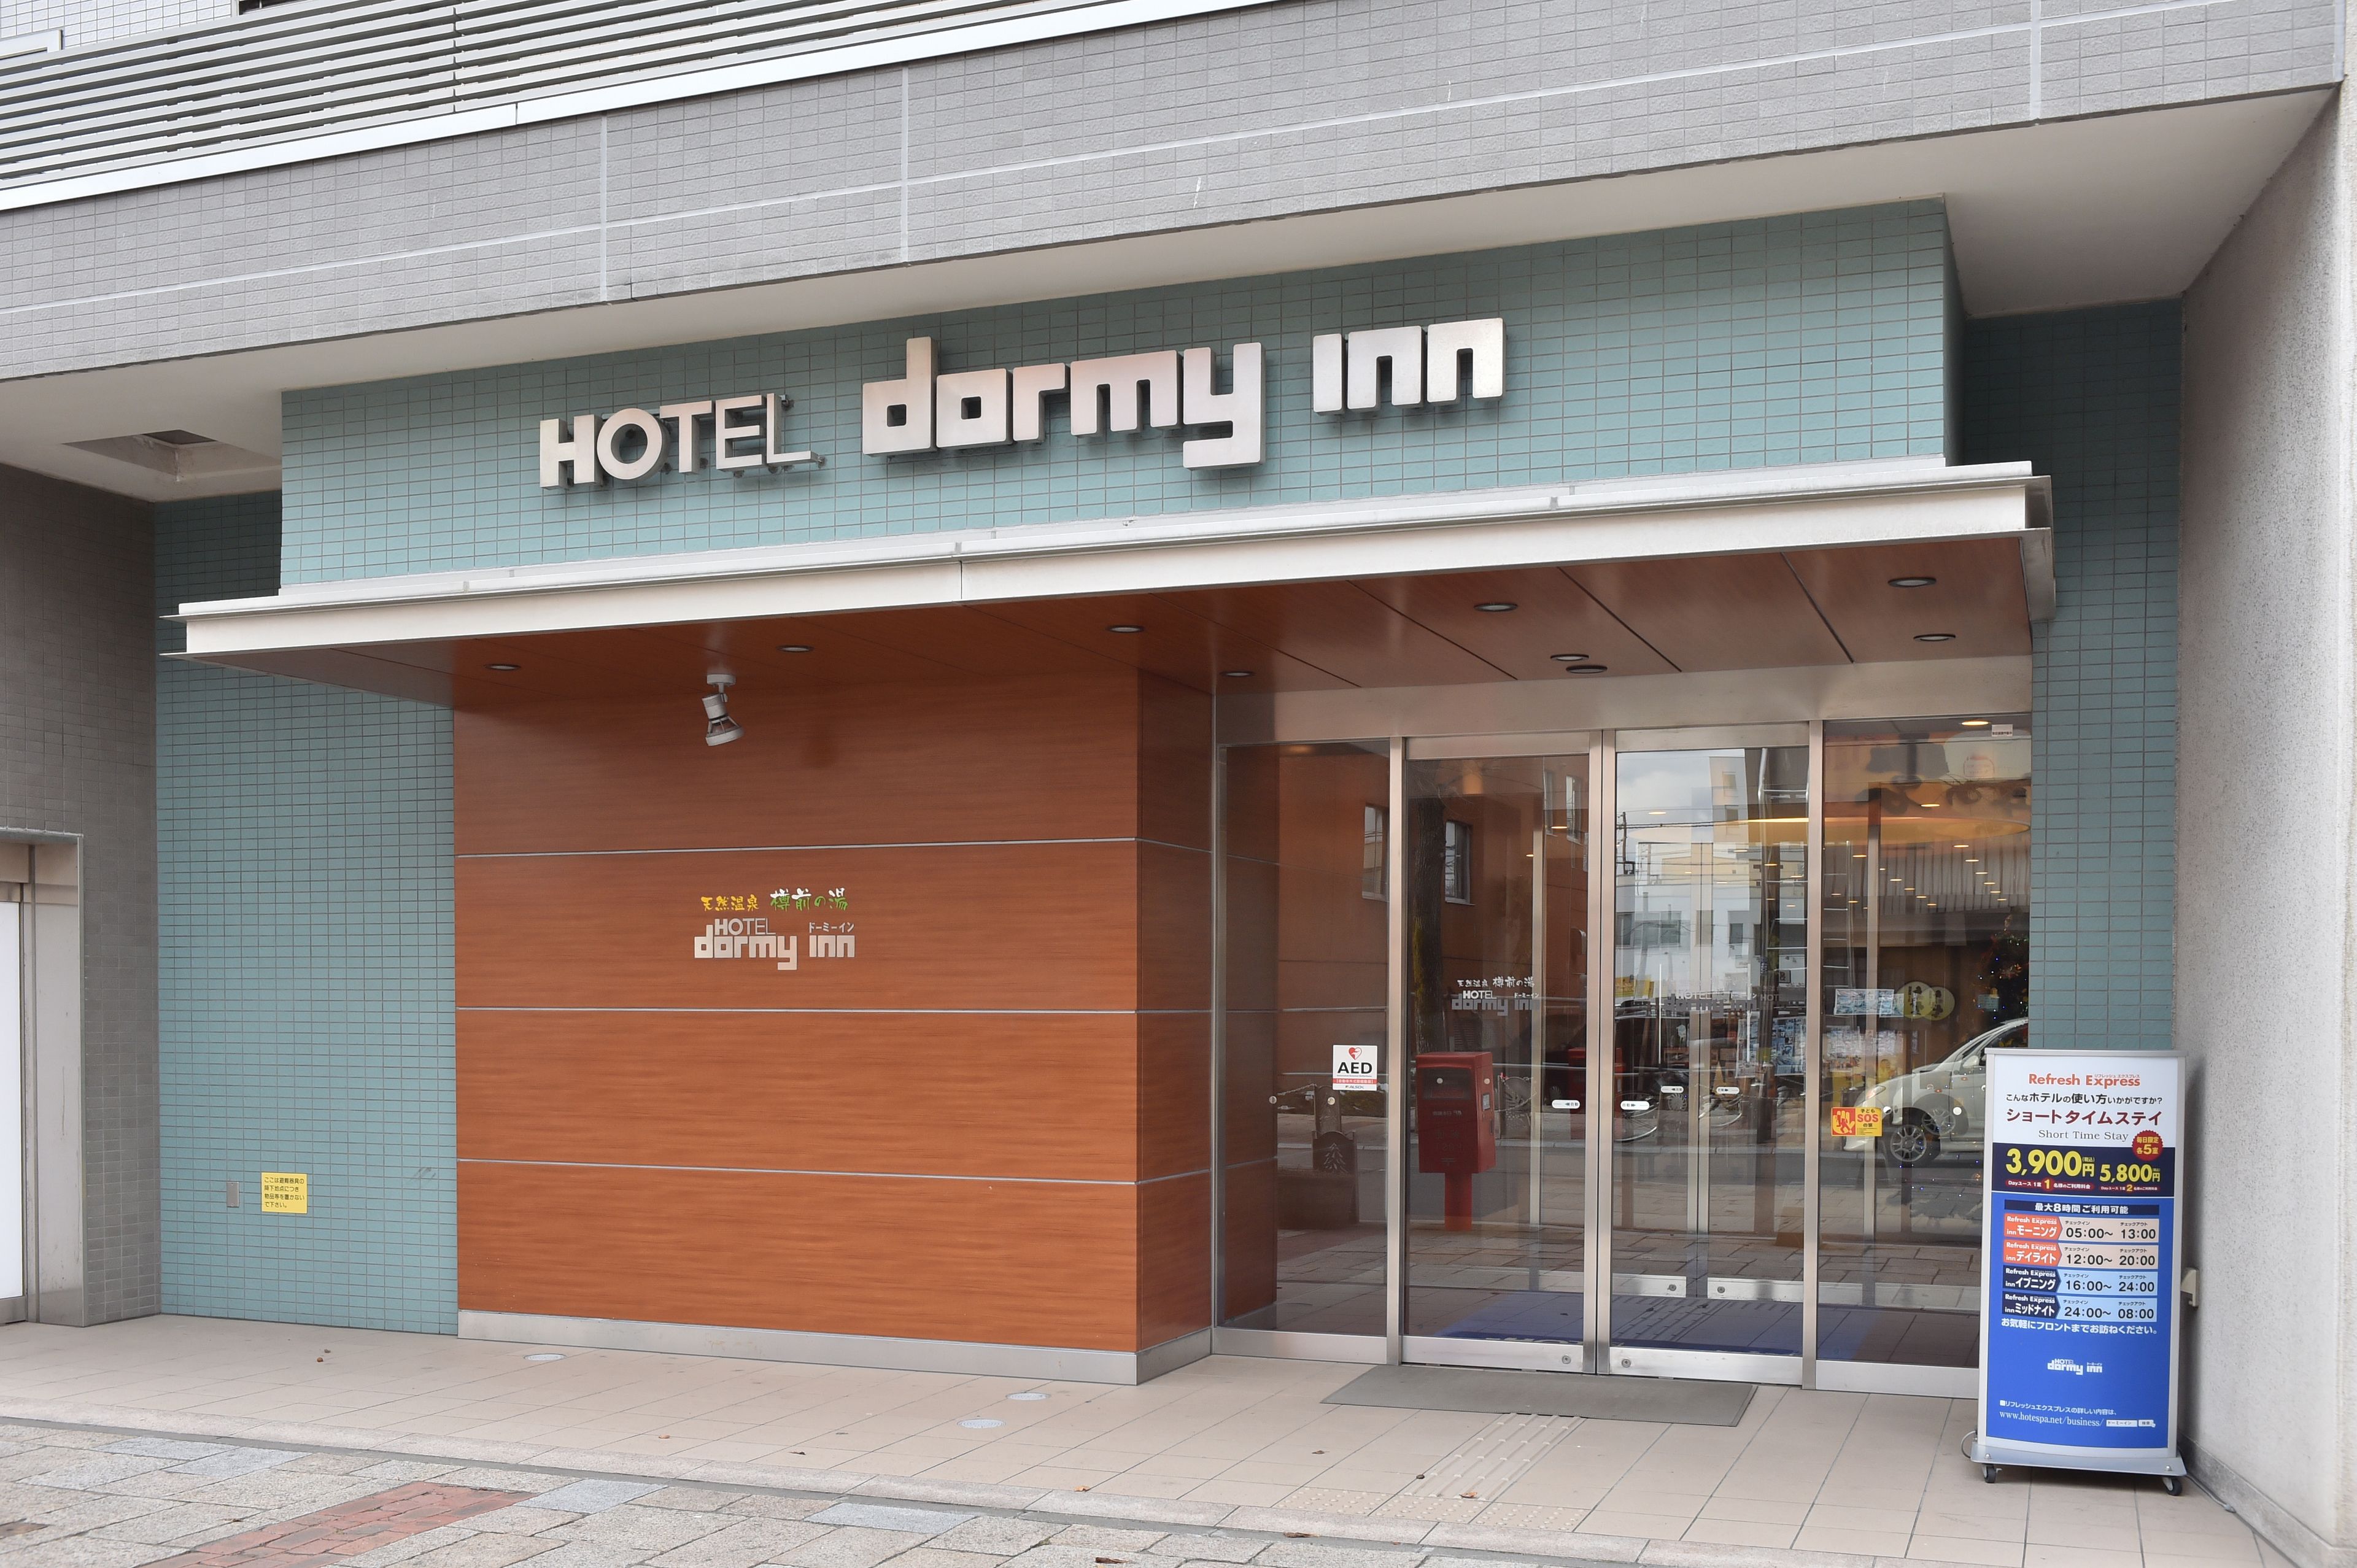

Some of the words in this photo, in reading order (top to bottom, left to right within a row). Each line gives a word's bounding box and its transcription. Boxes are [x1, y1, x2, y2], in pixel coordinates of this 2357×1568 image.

[538, 393, 824, 491] HOTEL
[862, 336, 1266, 471] dormy
[1312, 317, 1506, 416] inn
[700, 894, 759, 911] 天然温泉
[770, 887, 849, 911] 樽前の湯
[714, 917, 776, 936] HOTEL
[808, 922, 854, 933] ドーミーイン
[694, 924, 797, 970] dormy
[809, 935, 855, 957] inn
[1463, 990, 1497, 999] HOTEL
[1452, 993, 1509, 1016] dormy
[1337, 1062, 1372, 1074] AED
[2029, 1073, 2081, 1086] Refresh
[2086, 1075, 2141, 1089] Express
[2005, 1092, 2163, 1105] こんなホテルの使い方いかがですか？
[1857, 1114, 1879, 1122] SOS
[2006, 1108, 2162, 1126] ショートタイムステイ
[2038, 1130, 2069, 1140] Short
[2072, 1130, 2100, 1140] Time
[2103, 1132, 2129, 1142] Stay
[2137, 1145, 2159, 1154] 各5室
[2121, 1229, 2156, 1239] 13:00
[2119, 1255, 2155, 1265] 20:00
[2118, 1281, 2154, 1292] 24:00
[2118, 1308, 2154, 1319] 08:00
[2000, 1318, 2158, 1335] お気軽にフロントまでお訪ねください。
[2047, 1359, 2083, 1375] dormy
[1999, 1411, 2105, 1427] www.hotespa.net/business/
